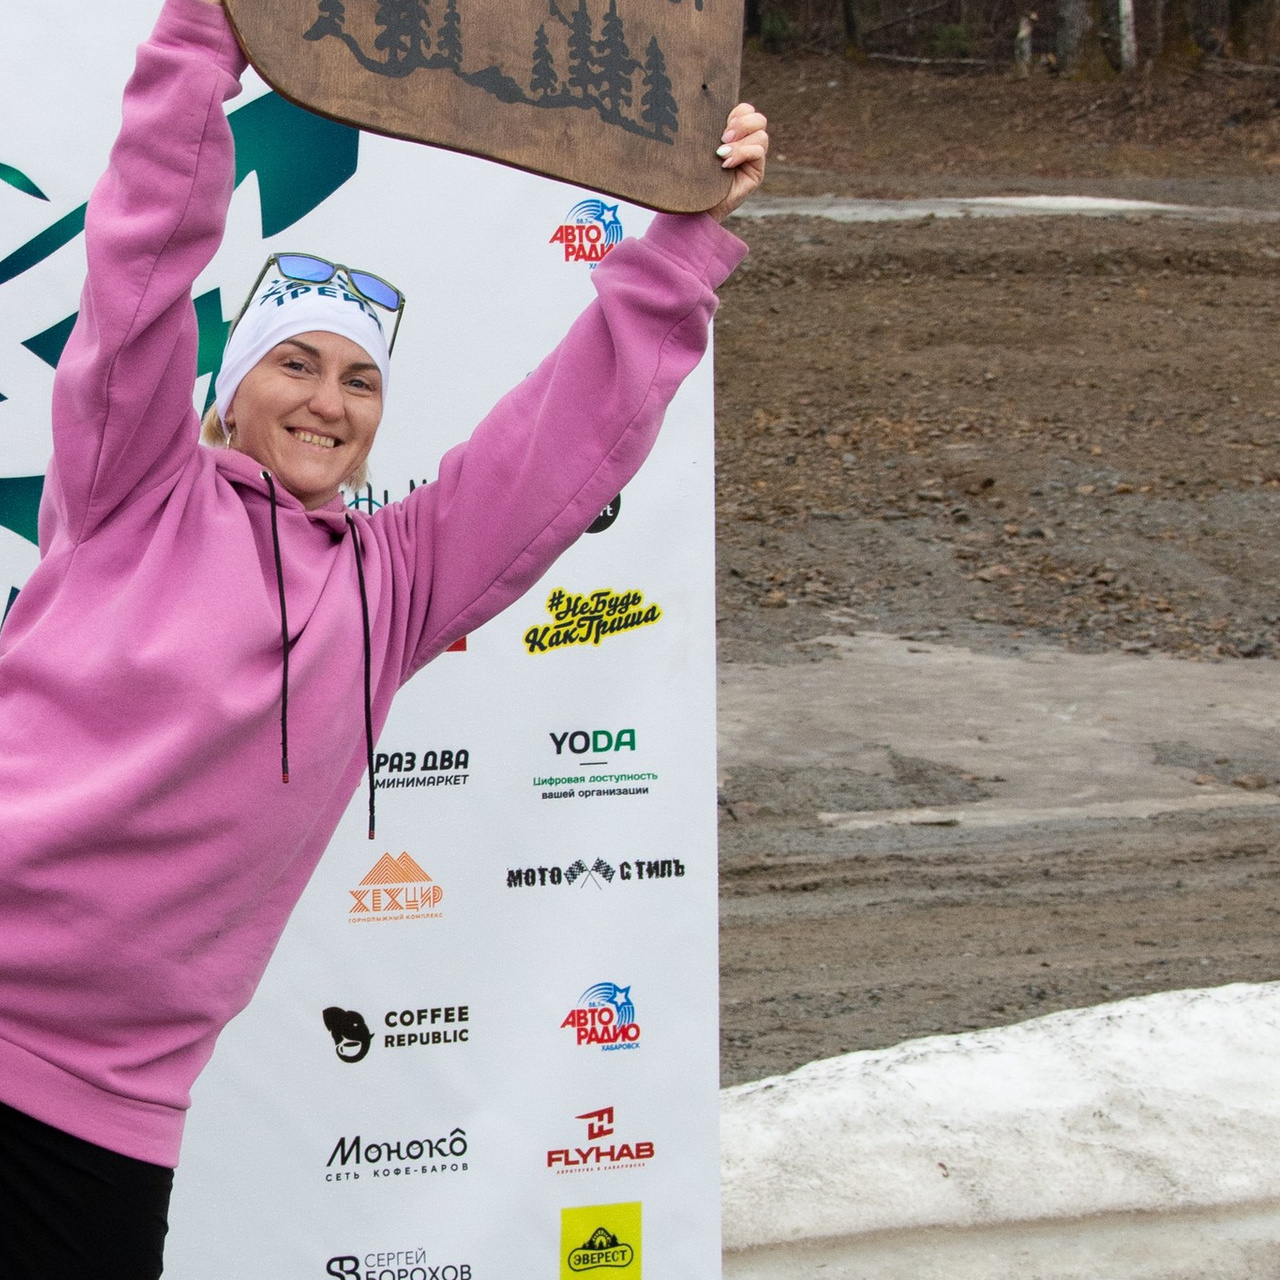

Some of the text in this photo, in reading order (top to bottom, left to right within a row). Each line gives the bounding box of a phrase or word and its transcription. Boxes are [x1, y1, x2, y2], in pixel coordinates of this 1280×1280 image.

[549, 225, 601, 243] АВТО
[565, 243, 614, 262] РАДИ
[549, 729, 636, 755] YODA
[375, 749, 469, 773] РАЗ ДВА
[375, 775, 469, 789] МИНИМАРКЕТ
[533, 772, 658, 786] Цифровая доступность
[542, 787, 649, 799] вашей организации
[506, 866, 562, 888] МОТО
[349, 885, 443, 913] ХЕХЦИР
[385, 1006, 468, 1027] COFFEE
[560, 1007, 614, 1028] АВТО
[385, 1029, 468, 1047] REPUBLIC
[577, 1023, 640, 1045] РАДИО
[547, 1142, 654, 1167] FLYHAB
[326, 1163, 469, 1182] СЕТЬ КОФЕ-БАРОВ
[365, 1247, 426, 1268] СЕРГЕЙ
[574, 1249, 628, 1266] ЭВЕРЕСТ
